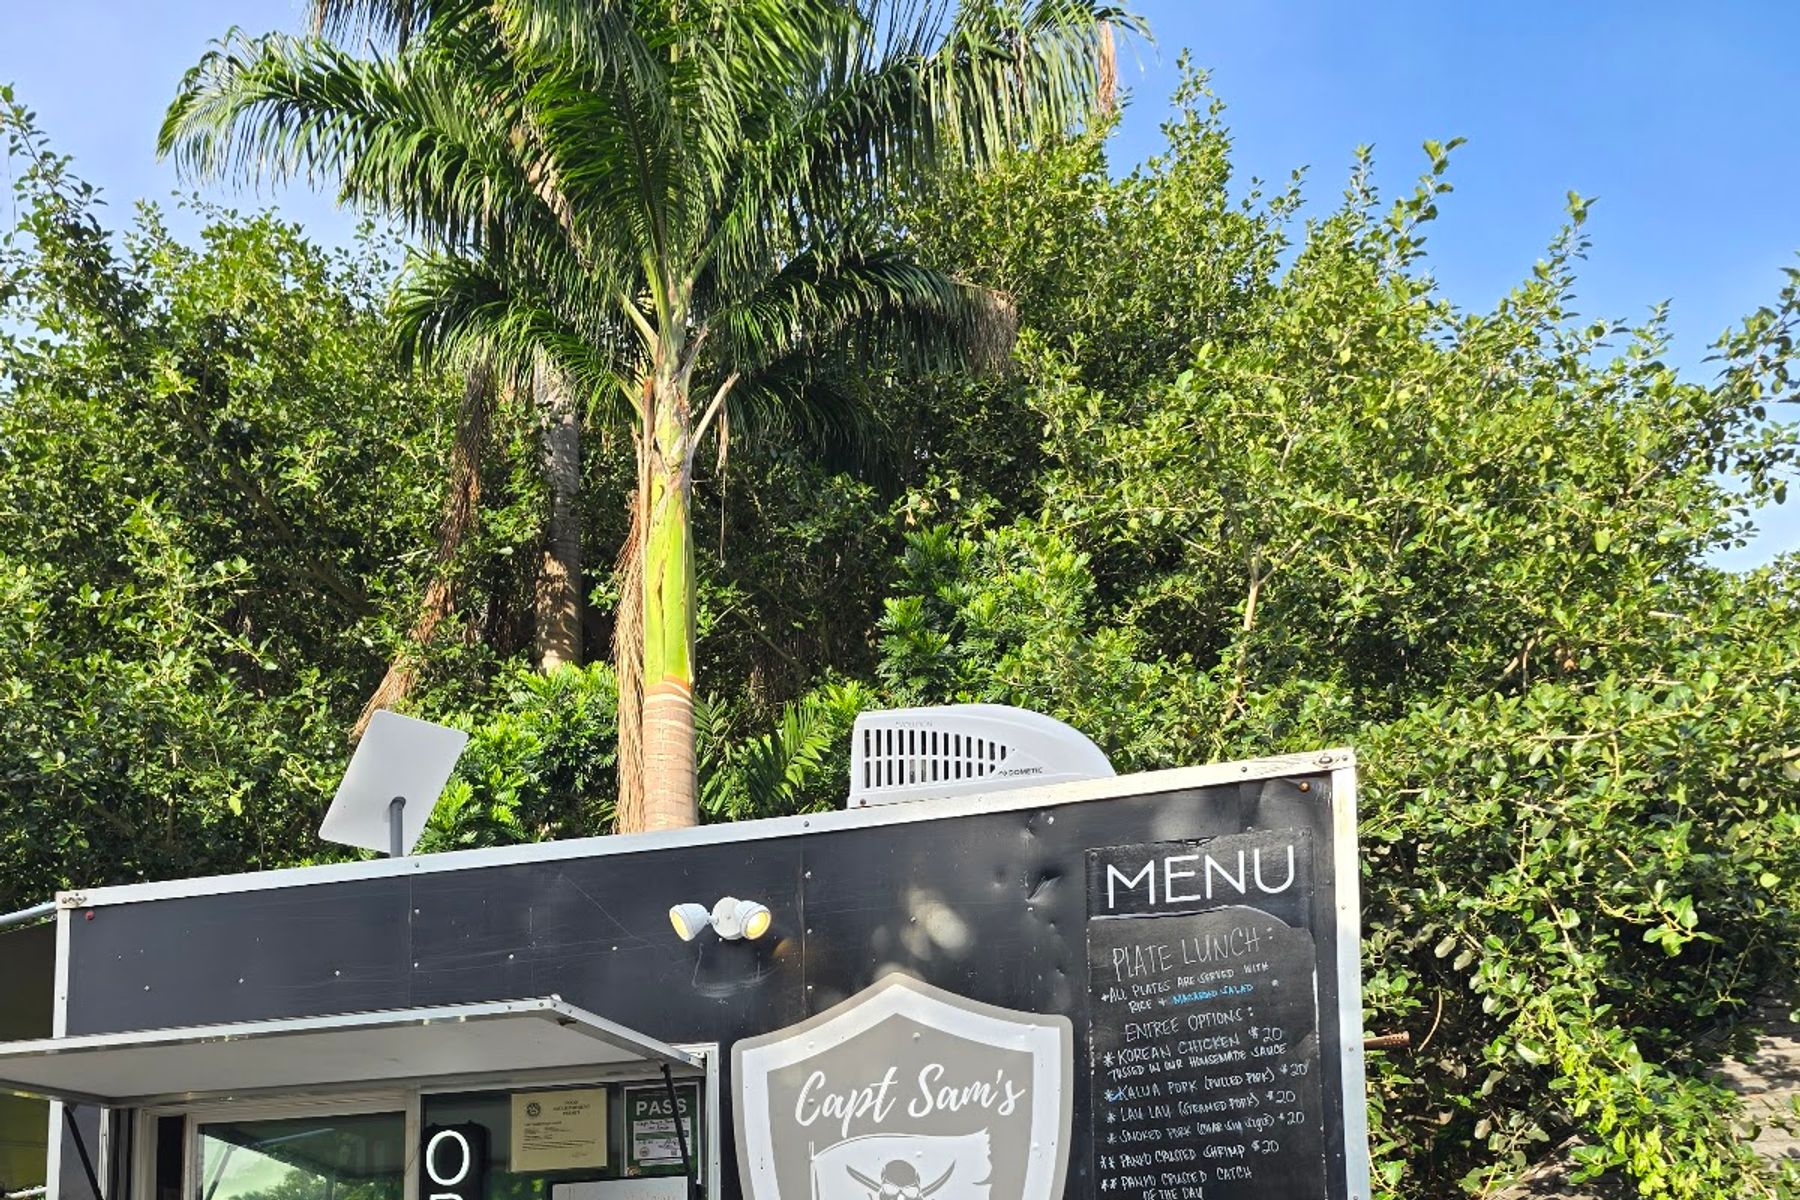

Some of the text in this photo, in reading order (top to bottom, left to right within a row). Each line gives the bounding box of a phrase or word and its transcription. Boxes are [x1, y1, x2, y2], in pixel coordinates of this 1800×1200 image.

[1107, 845, 1294, 908] MENU
[1113, 945, 1173, 982] PLATE
[1110, 961, 1269, 1003] ALL PLATES ARE SERVED WITH
[1128, 1000, 1152, 1013] RICE
[1220, 984, 1254, 995] SALAD
[1125, 1016, 1179, 1043] ENTREE
[1117, 1026, 1283, 1066] KOREAN CHICKEN $20
[1149, 1061, 1161, 1073] IN
[1164, 1059, 1183, 1071] OUR
[1251, 1043, 1287, 1058] SAUCE
[1167, 1080, 1199, 1095] PORK
[1204, 1074, 1244, 1091] (PULLED
[636, 1098, 687, 1116] PASS
[795, 1063, 1025, 1138] Capt Sam's
[1120, 1107, 1144, 1121] LAU
[1149, 1104, 1171, 1119] LAU
[1178, 1100, 1227, 1116] (STEAMED
[1265, 1090, 1296, 1104] $20
[1119, 1129, 1162, 1142] SMOKED
[1166, 1125, 1192, 1140] PORK
[1277, 1112, 1305, 1125] $20
[1120, 1140, 1280, 1168] PANKO CRUSTED SHRIMP $20
[1121, 1166, 1252, 1191] PANKO CRUSTED CATCH
[1158, 1187, 1179, 1200] THE
